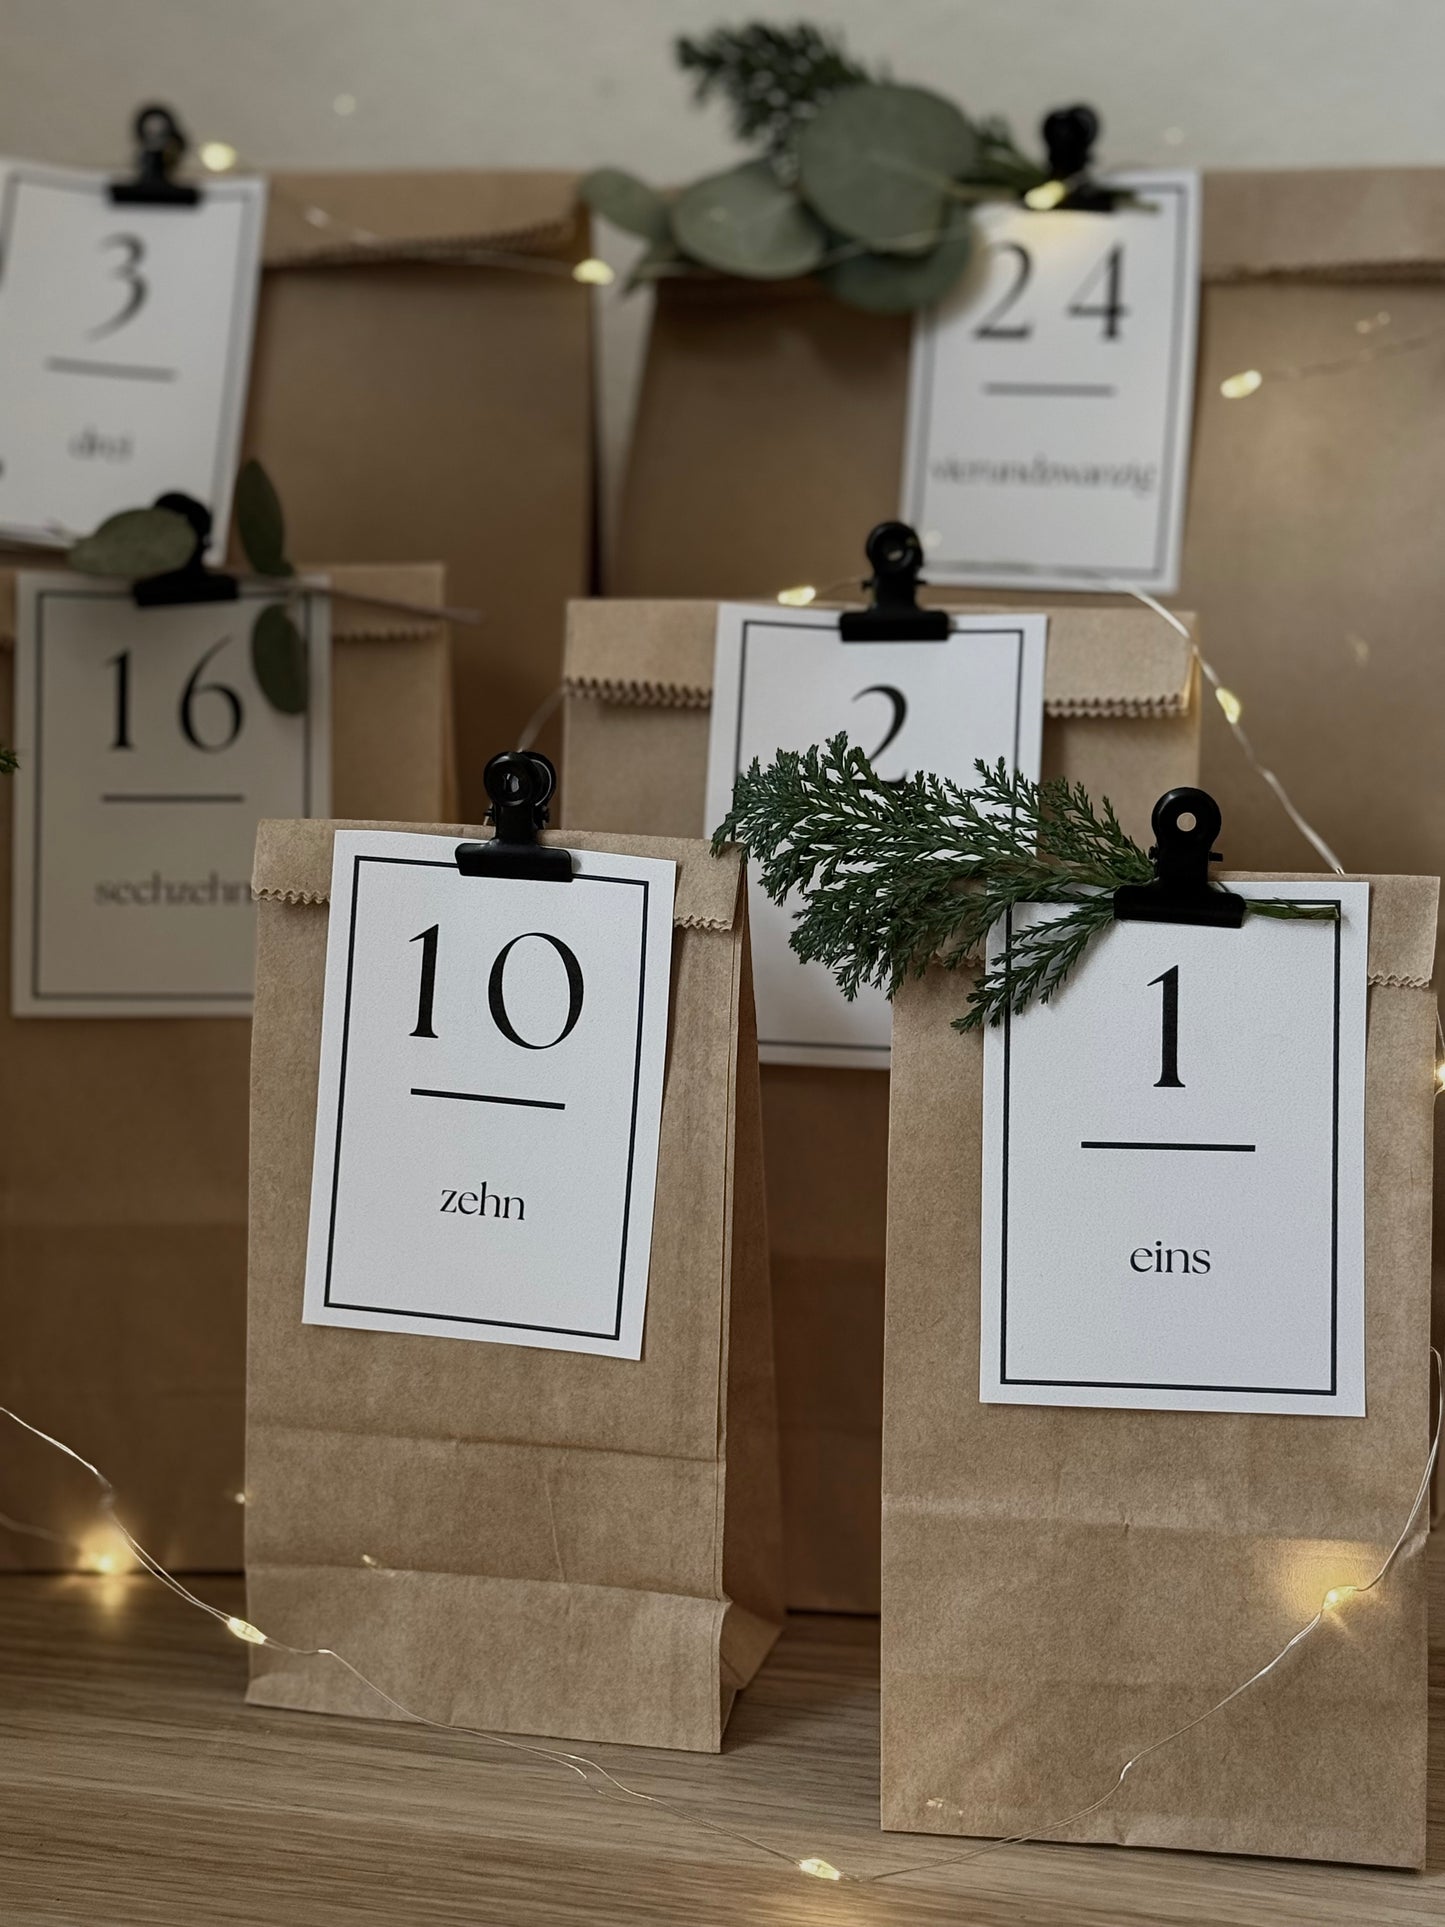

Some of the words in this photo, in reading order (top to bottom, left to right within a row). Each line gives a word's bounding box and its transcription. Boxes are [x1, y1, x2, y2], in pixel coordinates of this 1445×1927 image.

[84, 231, 149, 341] 3
[972, 241, 1129, 342] 24
[103, 632, 244, 753] 16
[851, 684, 908, 790] 2
[409, 924, 584, 1050] 10
[1147, 965, 1186, 1088] 1
[439, 1181, 525, 1221] zehn
[1130, 1240, 1211, 1275] eins
